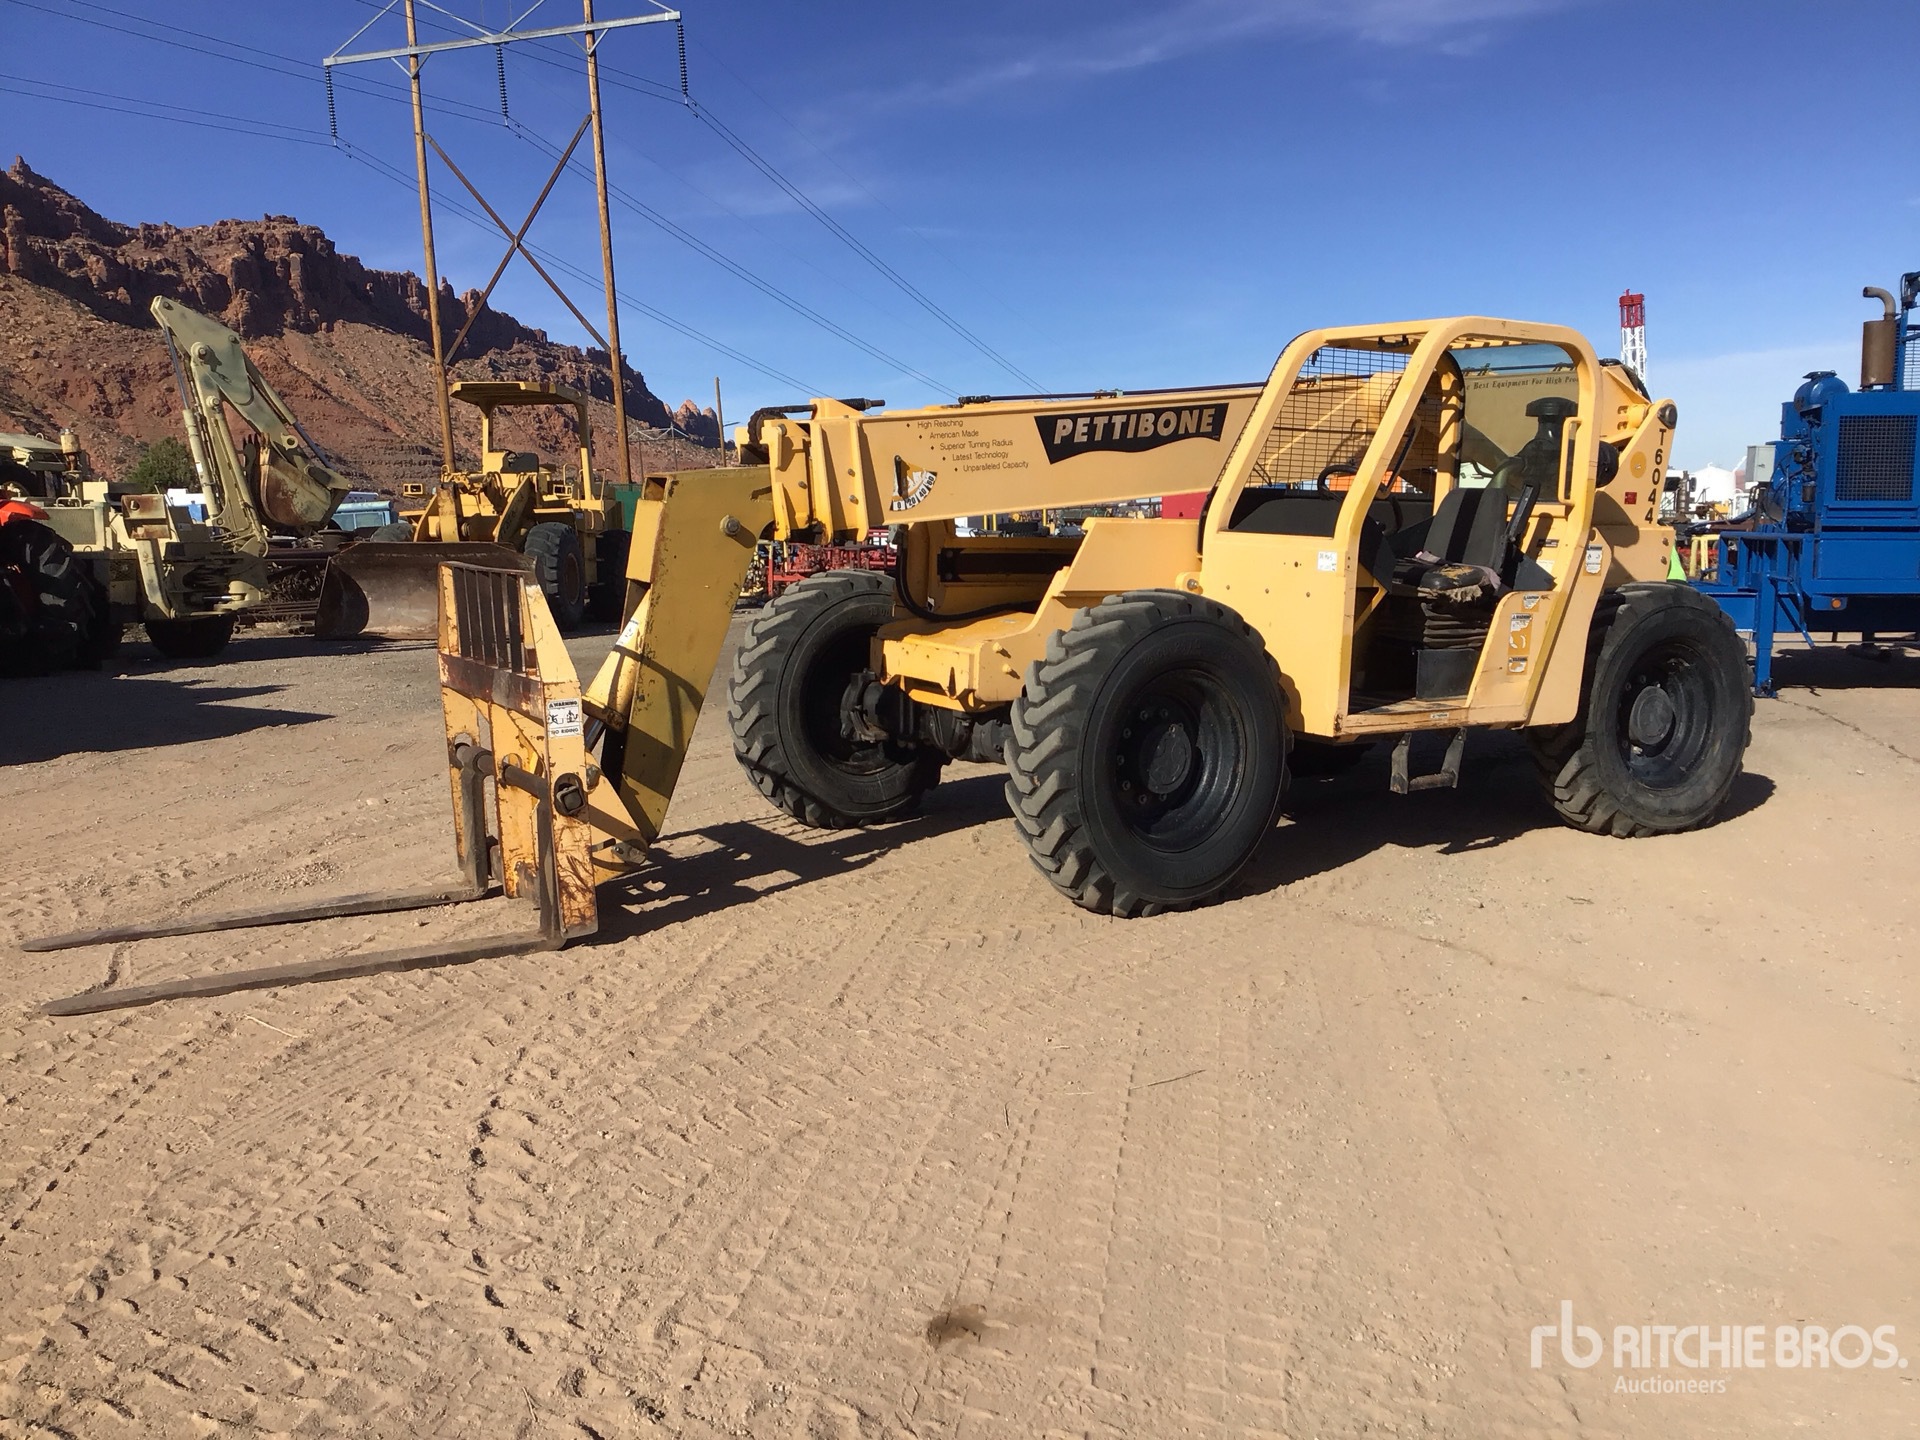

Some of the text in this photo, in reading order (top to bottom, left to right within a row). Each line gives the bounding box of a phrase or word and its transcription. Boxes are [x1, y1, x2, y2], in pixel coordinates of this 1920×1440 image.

[1473, 382, 1489, 390] Best
[1492, 378, 1529, 388] Equipment
[1531, 377, 1542, 385] For
[1545, 376, 1562, 385] High
[917, 419, 964, 430] High Reaching
[1053, 408, 1216, 445] PETTIBONE
[929, 429, 979, 439] American Made
[940, 439, 1013, 451] Superior Turning Radius
[952, 450, 1009, 461] Latest Technology
[963, 460, 1029, 472] Unparalleled Capacity
[1644, 427, 1667, 525] T6044
[896, 501, 902, 509] 0
[907, 496, 917, 507] 20
[918, 487, 927, 498] 40
